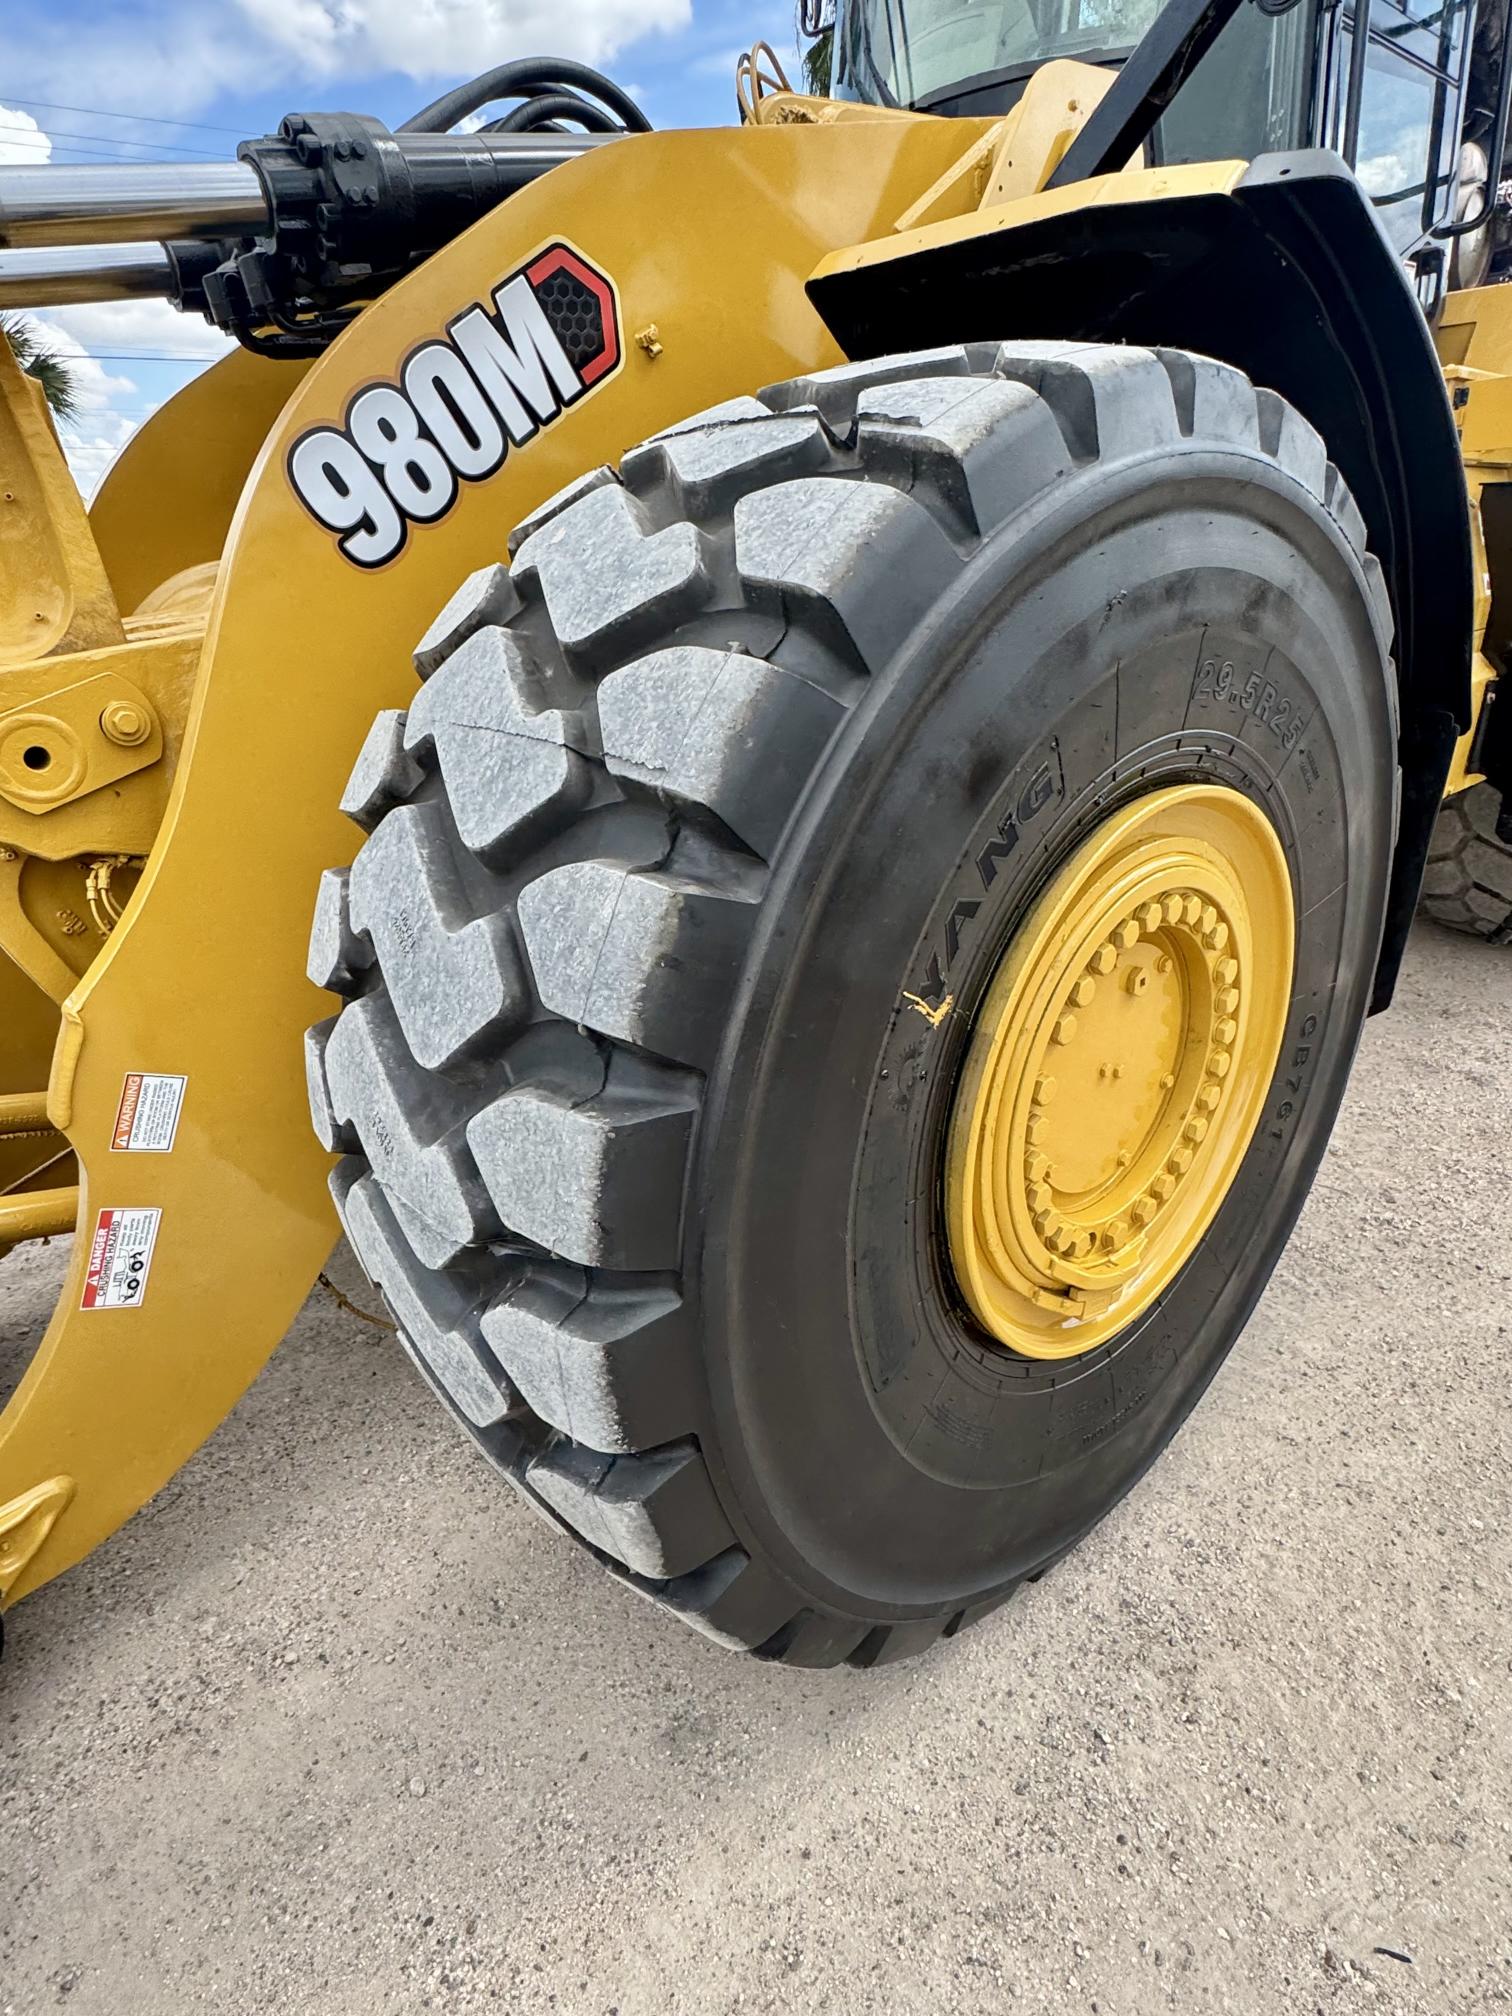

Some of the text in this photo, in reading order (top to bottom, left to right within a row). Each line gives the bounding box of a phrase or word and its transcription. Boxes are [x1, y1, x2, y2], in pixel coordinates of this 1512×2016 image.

[290, 272, 584, 563] 980M
[1192, 659, 1304, 750] 29.5R25
[119, 1076, 140, 1132] WARNING
[133, 1082, 151, 1143] CRUSHING HAZARD
[90, 1228, 109, 1271] DANGER
[97, 1220, 120, 1297] CRUSHING HAZARD
